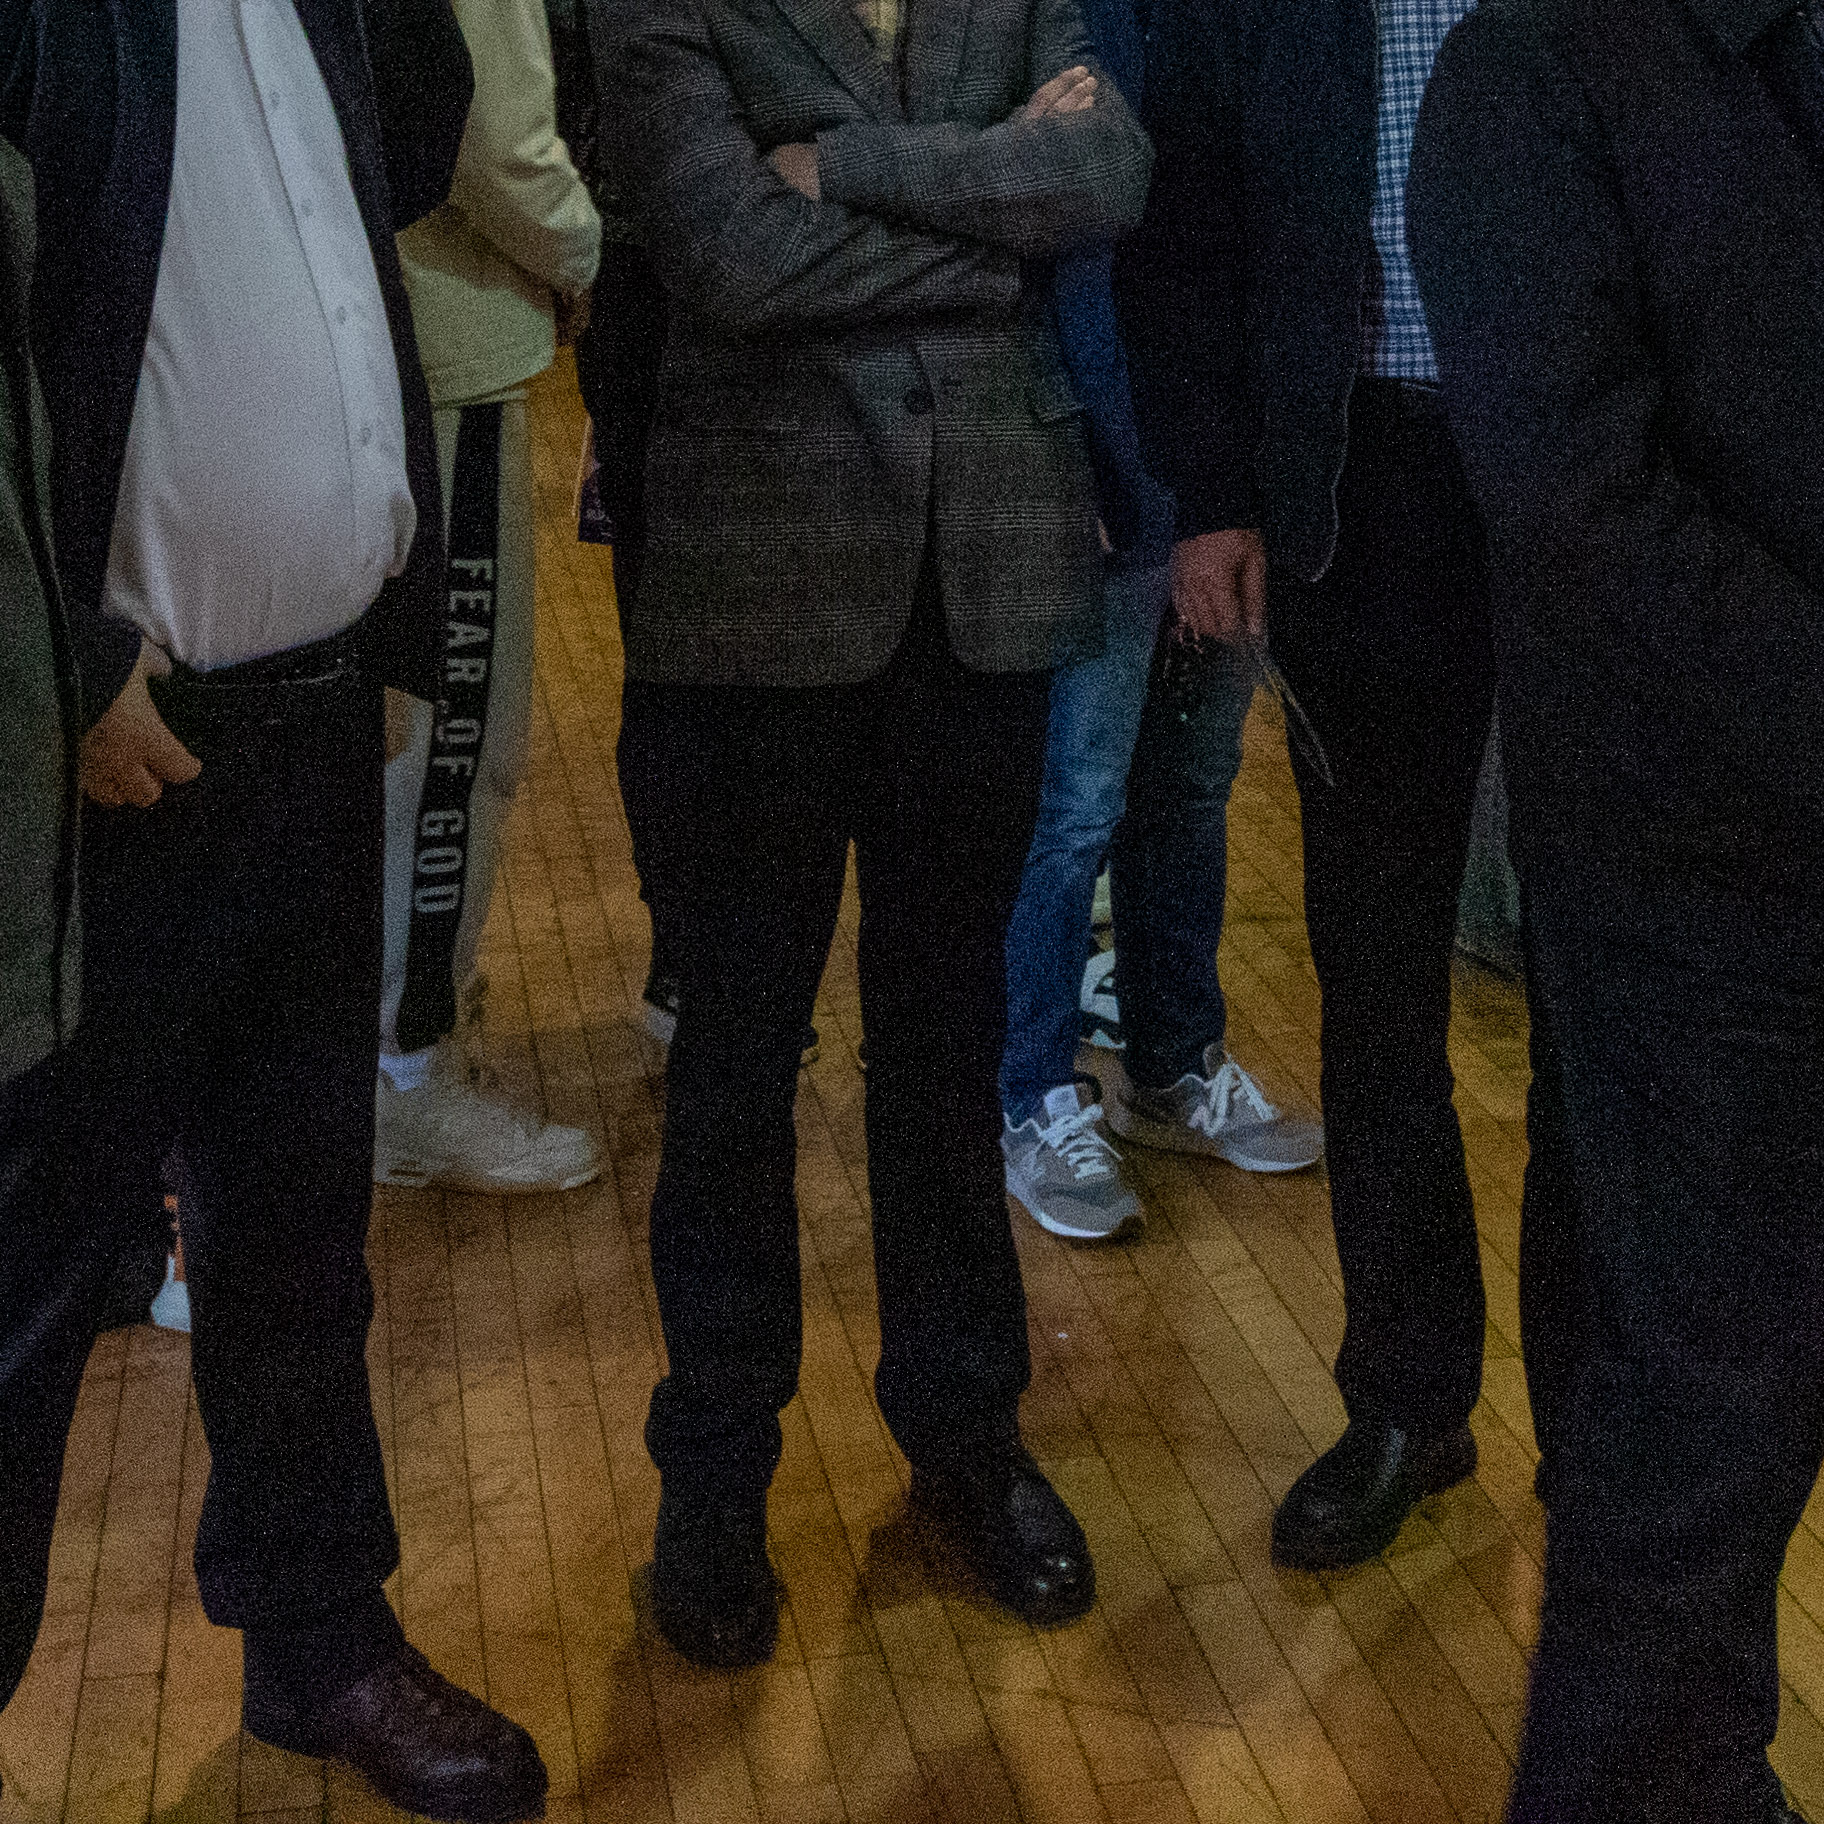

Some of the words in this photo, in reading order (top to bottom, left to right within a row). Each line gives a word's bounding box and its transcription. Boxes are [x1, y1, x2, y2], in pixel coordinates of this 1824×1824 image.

[446, 557, 495, 683] FEAR
[433, 716, 483, 778] OF
[413, 808, 466, 916] GOD
